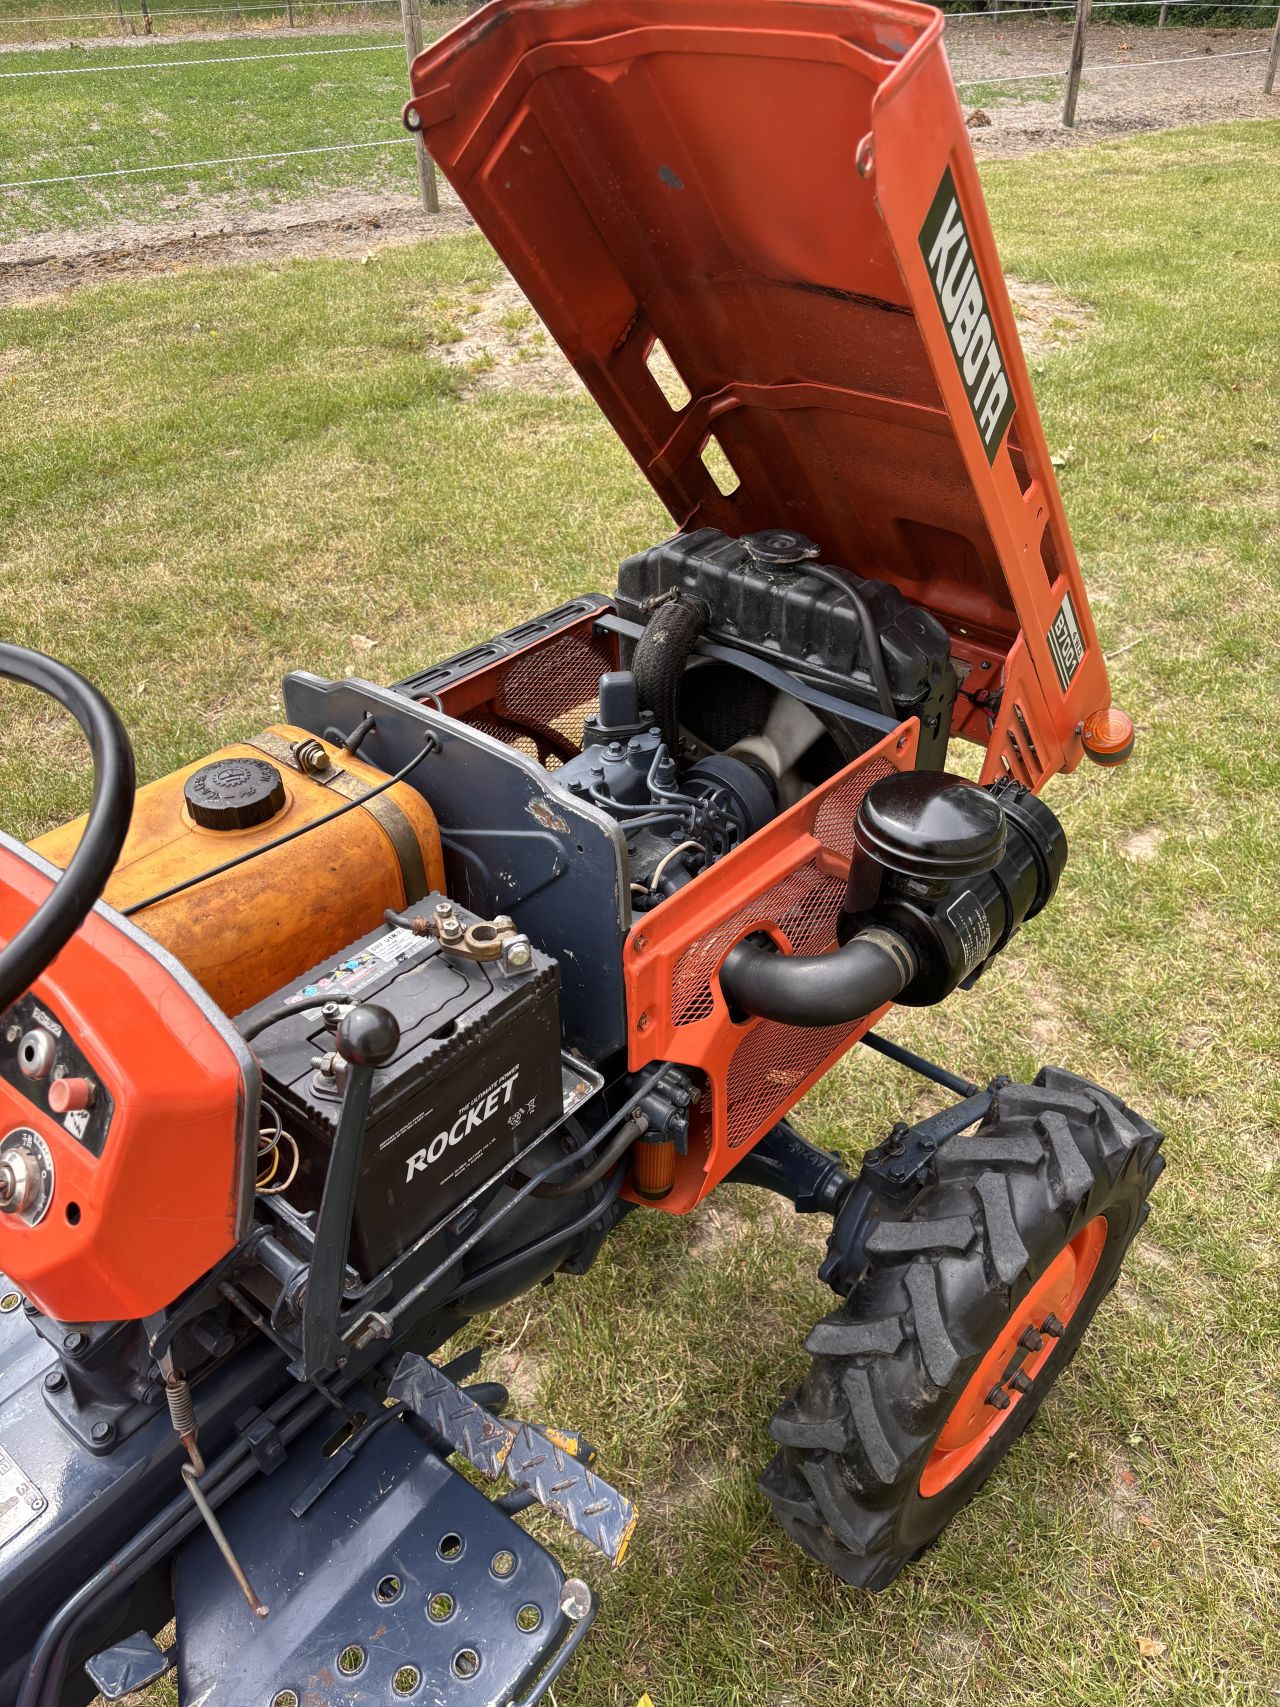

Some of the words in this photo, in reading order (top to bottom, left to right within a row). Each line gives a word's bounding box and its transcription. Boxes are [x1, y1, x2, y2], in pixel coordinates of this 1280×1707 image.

[929, 197, 1008, 446] KUBOTA
[1055, 613, 1077, 676] B7001
[405, 1072, 519, 1184] ROCKET
[458, 1102, 470, 1115] THE
[471, 1080, 498, 1106] ULTIMATE
[499, 1063, 520, 1084] POWER
